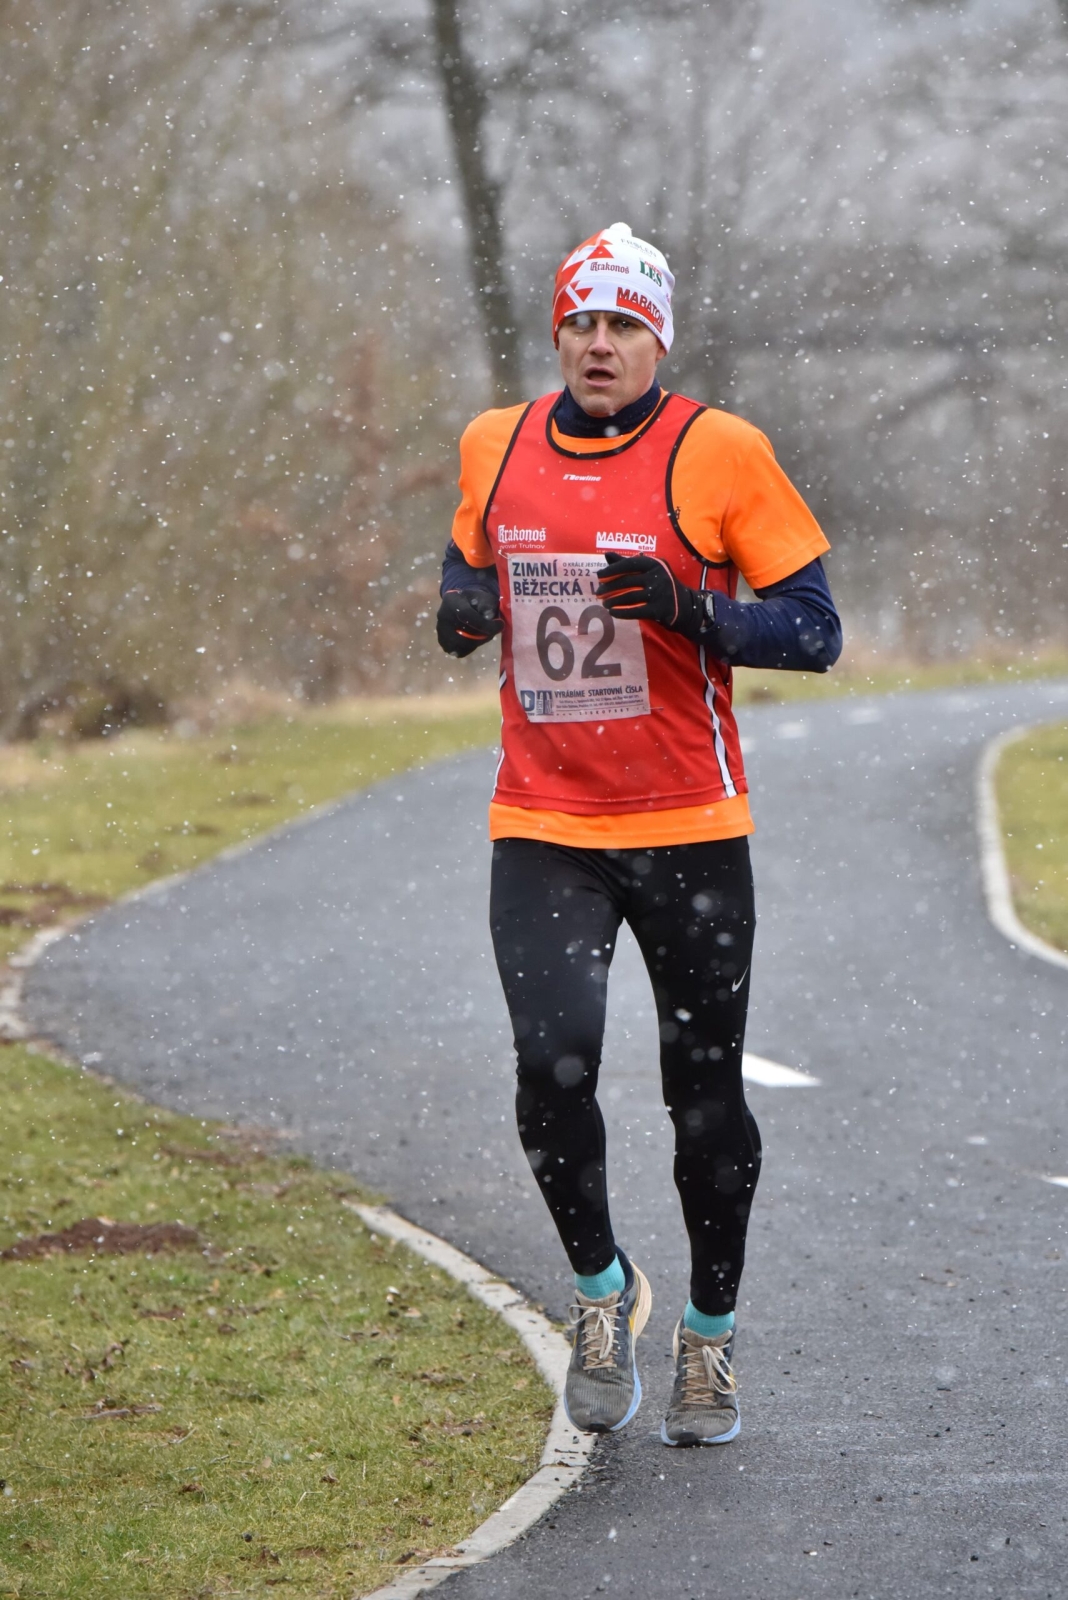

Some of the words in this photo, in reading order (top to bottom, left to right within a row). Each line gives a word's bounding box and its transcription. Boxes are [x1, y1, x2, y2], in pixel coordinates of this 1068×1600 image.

[639, 260, 662, 287] LES
[617, 287, 666, 326] MARATON
[498, 525, 546, 543] Krakonoš
[596, 532, 656, 545] MARATON
[512, 559, 559, 576] ZIMNÍ
[567, 560, 584, 568] KRÁLE
[514, 578, 583, 596] BĚŽECKÁ
[536, 605, 622, 681] 62
[554, 688, 586, 698] VYRÁBÍME
[588, 685, 623, 697] STARTOVNÍ
[625, 684, 643, 694] ČÍSLA
